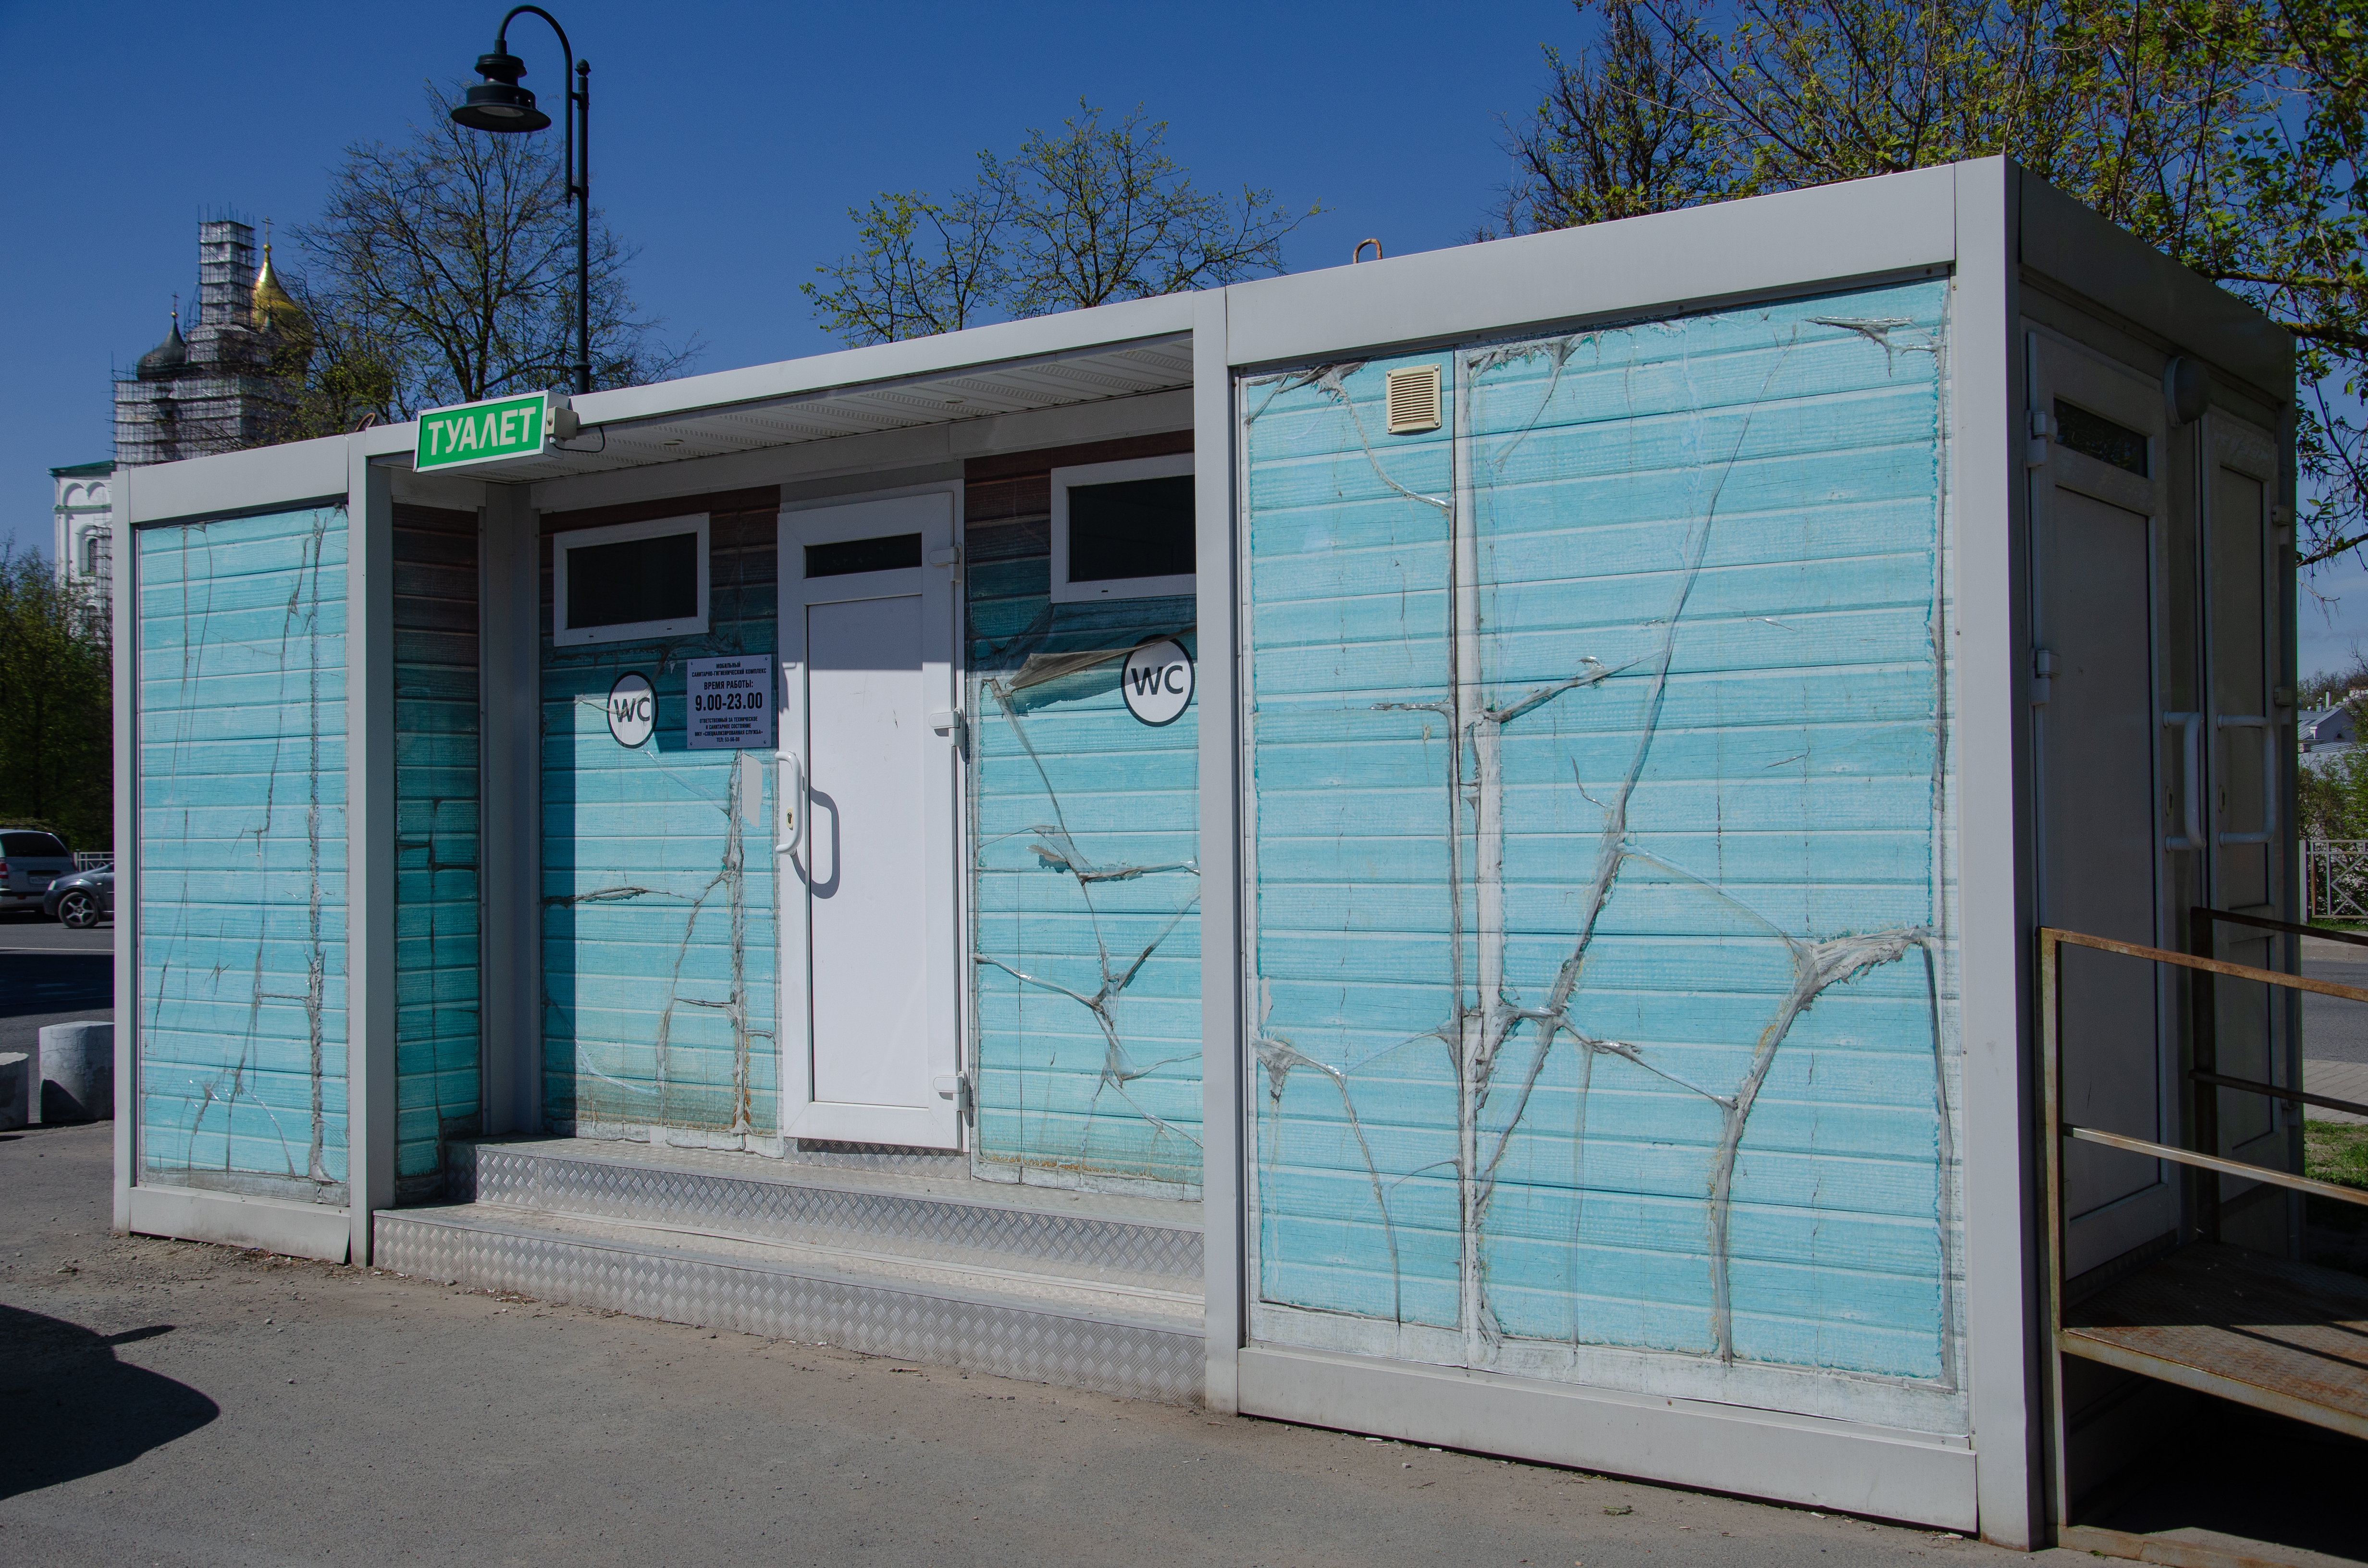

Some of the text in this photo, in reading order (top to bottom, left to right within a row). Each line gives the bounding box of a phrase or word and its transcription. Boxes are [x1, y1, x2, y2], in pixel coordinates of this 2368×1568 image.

[428, 406, 536, 455] ТУАЛЕТ
[692, 669, 744, 677] САНИТАРНО-ГИГИЕНИЧЕСКИЙ
[1131, 665, 1184, 696] WC
[704, 680, 753, 690] ВРЕМЯ РАБОТЫ:
[614, 697, 650, 723] WC
[695, 692, 763, 711] 9.00-23.00
